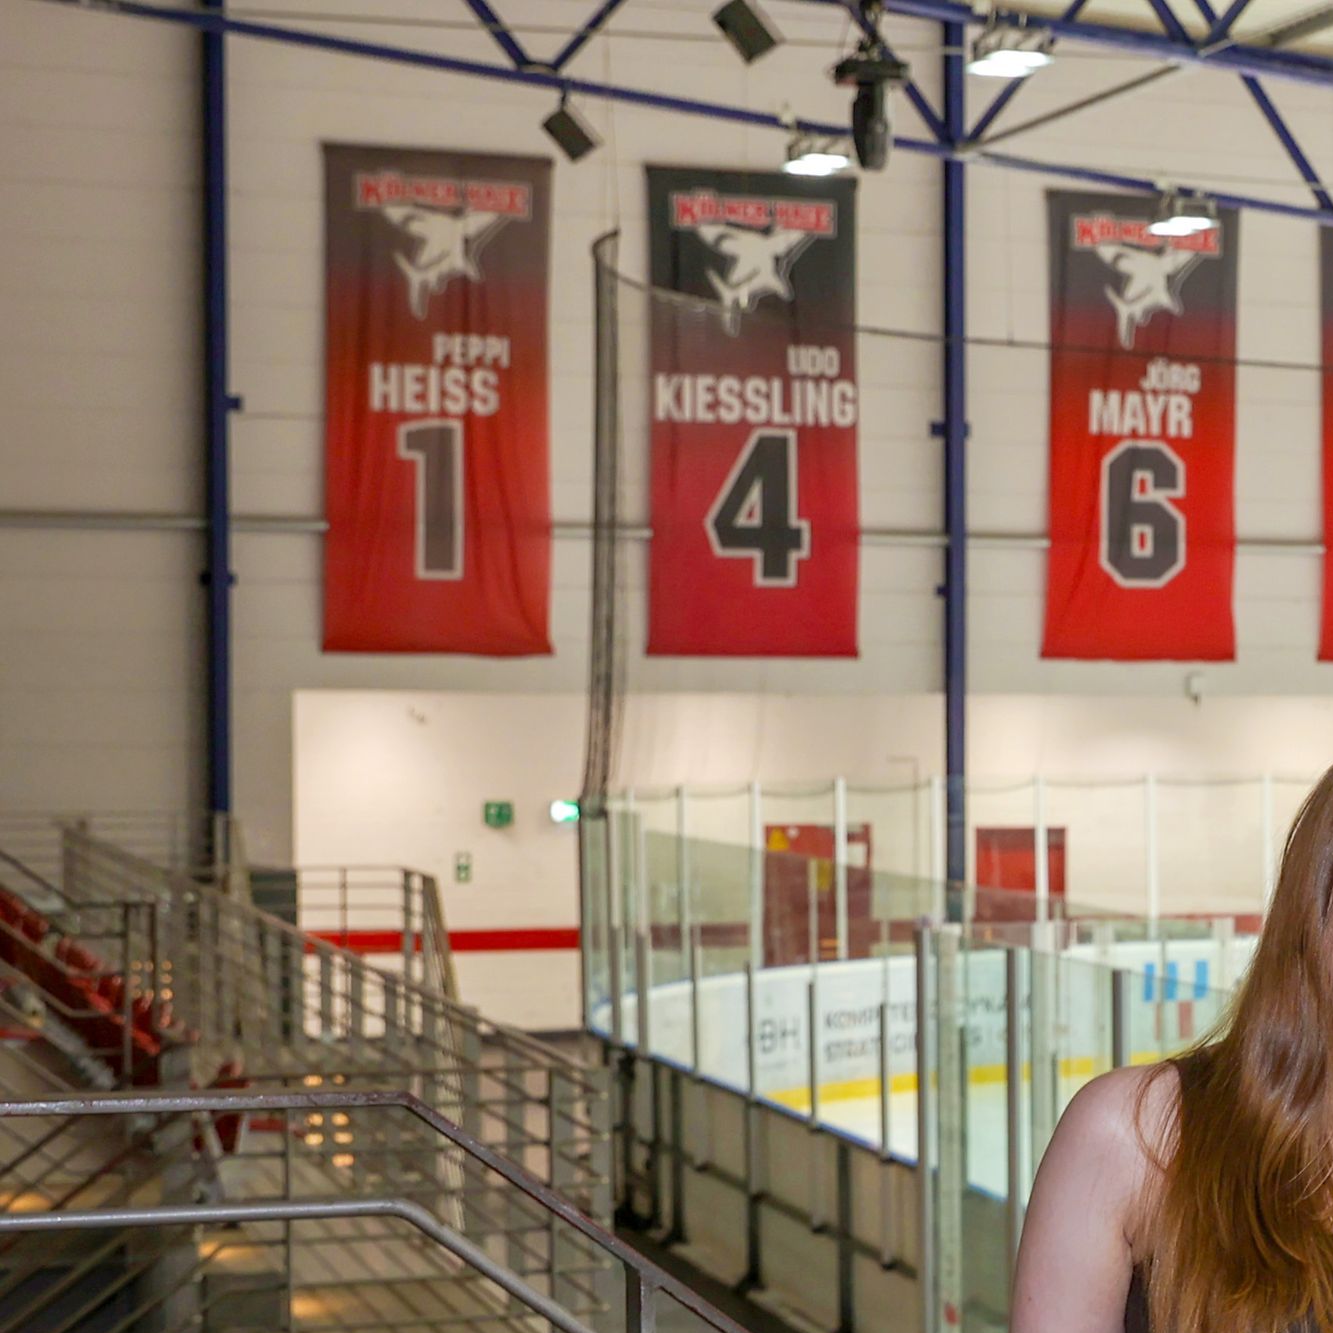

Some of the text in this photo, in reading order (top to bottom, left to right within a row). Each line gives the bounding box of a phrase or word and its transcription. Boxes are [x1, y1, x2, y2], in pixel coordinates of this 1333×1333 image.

[432, 333, 510, 369] PEPPI
[787, 346, 840, 377] UDO
[1140, 357, 1201, 394] JÖRG
[369, 363, 499, 416] HEISS
[654, 375, 857, 427] KIESSLING
[1089, 389, 1193, 438] MAYR
[397, 419, 464, 580] 1
[705, 427, 811, 586] 4
[1100, 439, 1186, 588] 6
